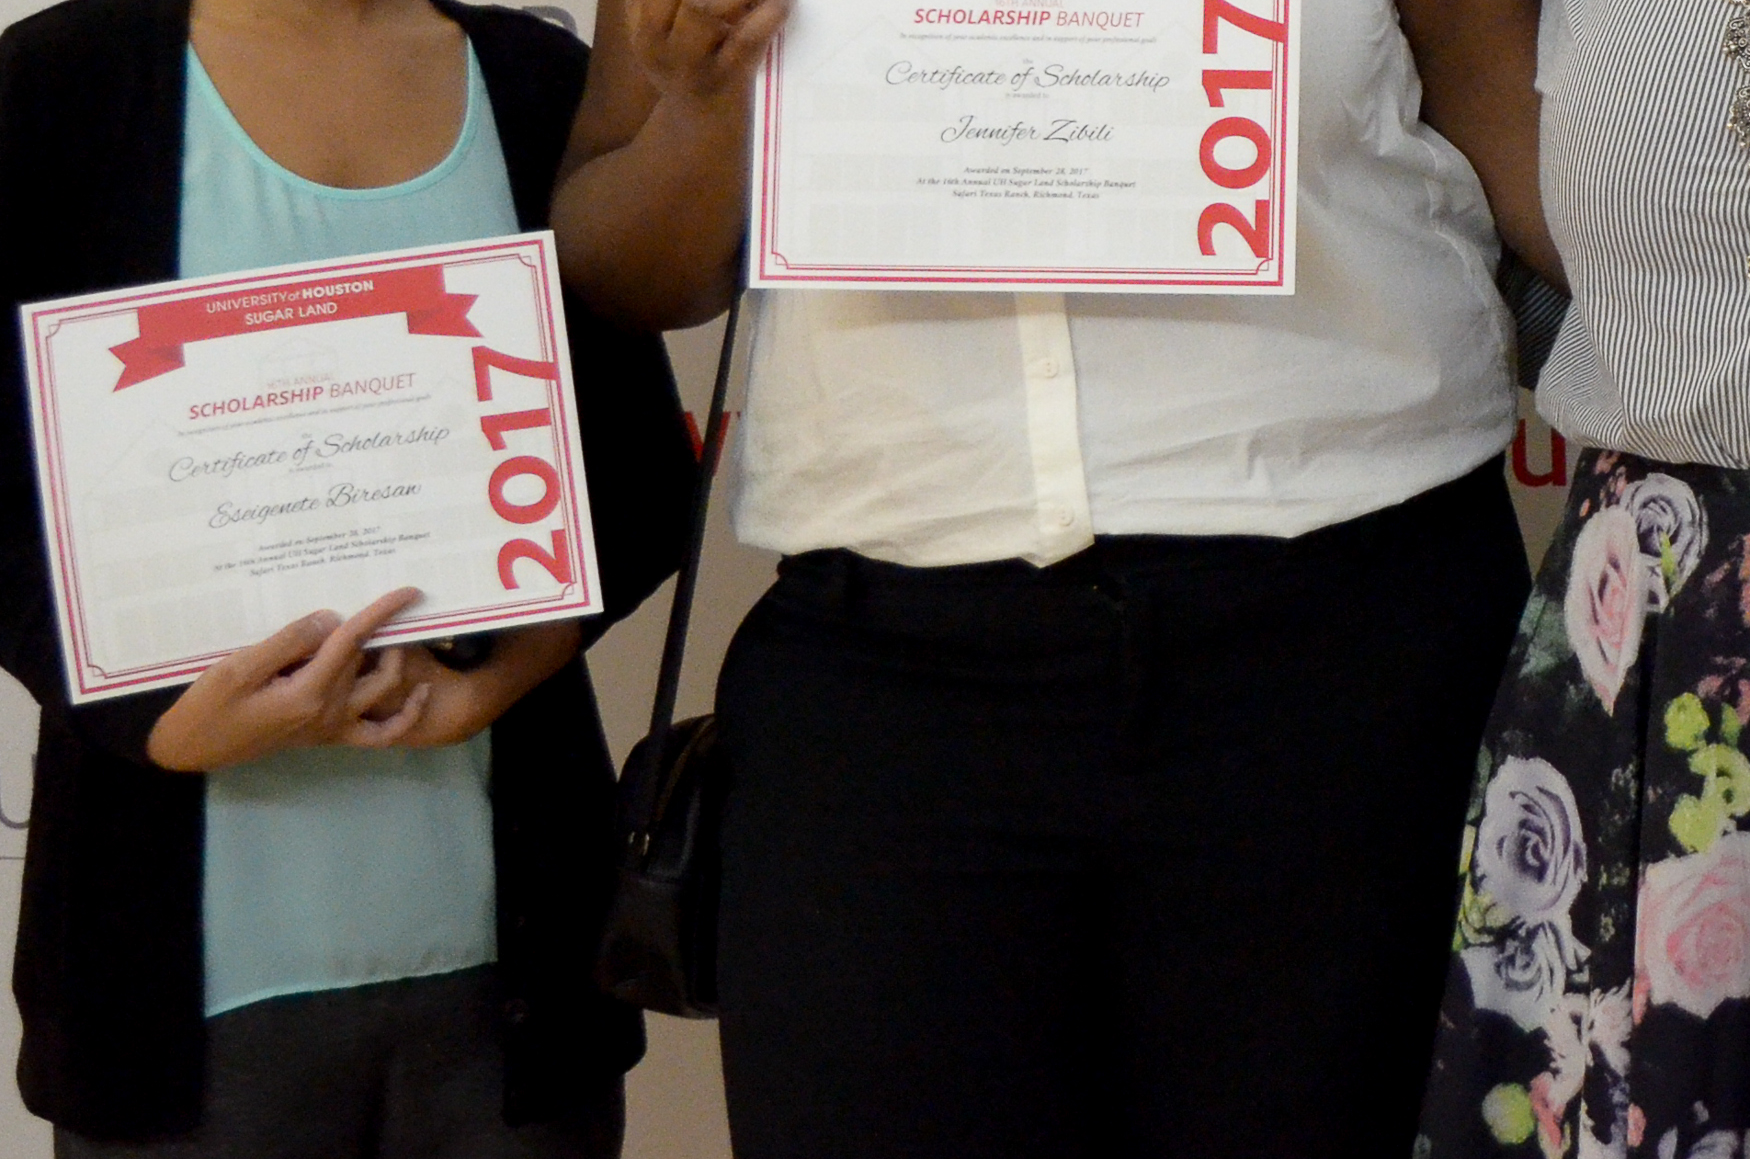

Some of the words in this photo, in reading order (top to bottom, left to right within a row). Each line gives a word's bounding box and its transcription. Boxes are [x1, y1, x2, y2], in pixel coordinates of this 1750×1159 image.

[914, 8, 1052, 26] SCHOLARSHIP
[1056, 11, 1145, 31] BANQUET
[885, 60, 1007, 91] Certificate
[1011, 67, 1034, 92] of
[1035, 63, 1171, 93] Scholarship
[940, 115, 1041, 146] Jennifer
[1043, 119, 1115, 144] Zibili
[206, 292, 287, 314] UNIVERSITY
[288, 292, 300, 302] of
[302, 280, 374, 300] HOUSTON
[245, 308, 293, 325] SUGAR
[299, 302, 338, 318] LAND
[189, 386, 324, 420] SCHOLARSHIP
[329, 373, 417, 398] BANQUET
[168, 451, 288, 483] Certificate
[292, 440, 315, 466] of
[315, 426, 450, 458] Scholarship
[472, 345, 573, 590] 2017
